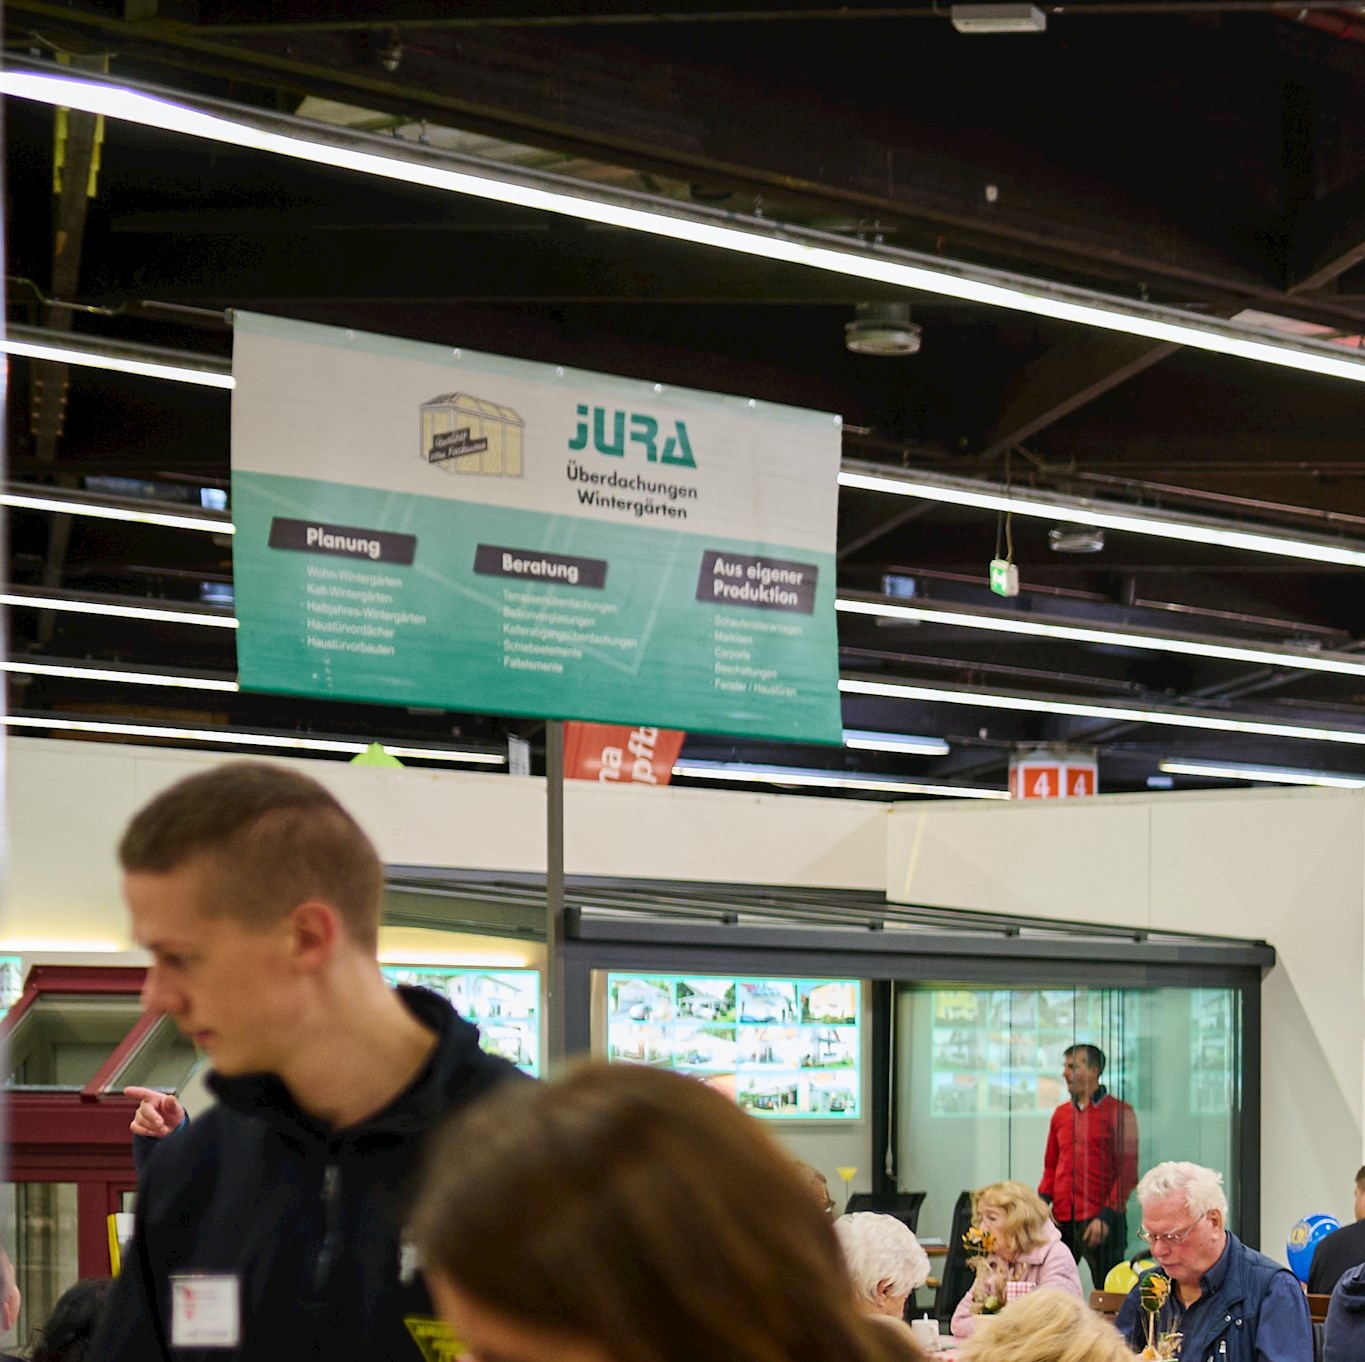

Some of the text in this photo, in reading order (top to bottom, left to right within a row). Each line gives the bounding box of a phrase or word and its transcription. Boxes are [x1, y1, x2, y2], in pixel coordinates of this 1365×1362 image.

[567, 459, 698, 499] Überdachungen
[577, 488, 688, 519] Wintergärten
[306, 527, 381, 559] Planung
[502, 553, 579, 584] Beratung
[713, 557, 804, 585] Aus eigener
[713, 579, 799, 606] Produktion
[1033, 771, 1051, 798] 4
